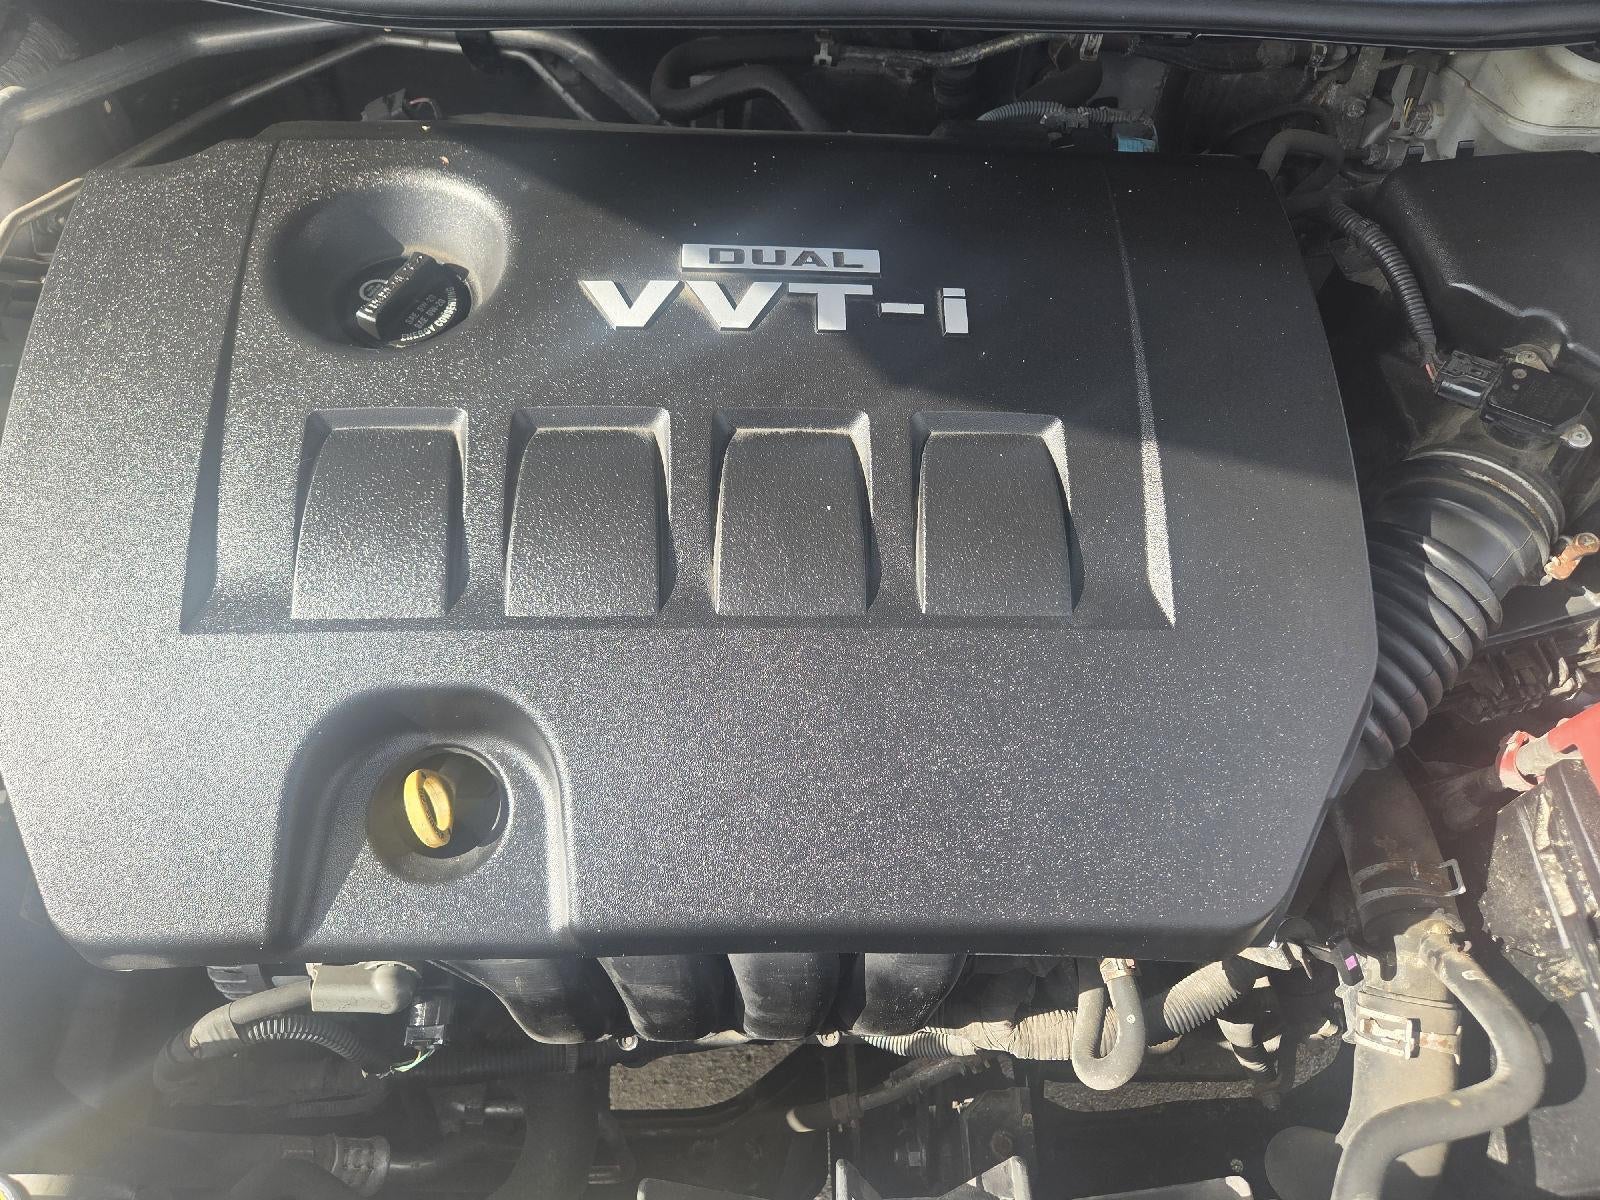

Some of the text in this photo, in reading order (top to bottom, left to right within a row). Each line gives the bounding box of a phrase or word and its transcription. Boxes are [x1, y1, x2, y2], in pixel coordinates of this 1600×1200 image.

[708, 247, 865, 269] DUAL
[400, 286, 458, 342] ENERGY CONSERVING
[579, 280, 969, 335] VVT-i
